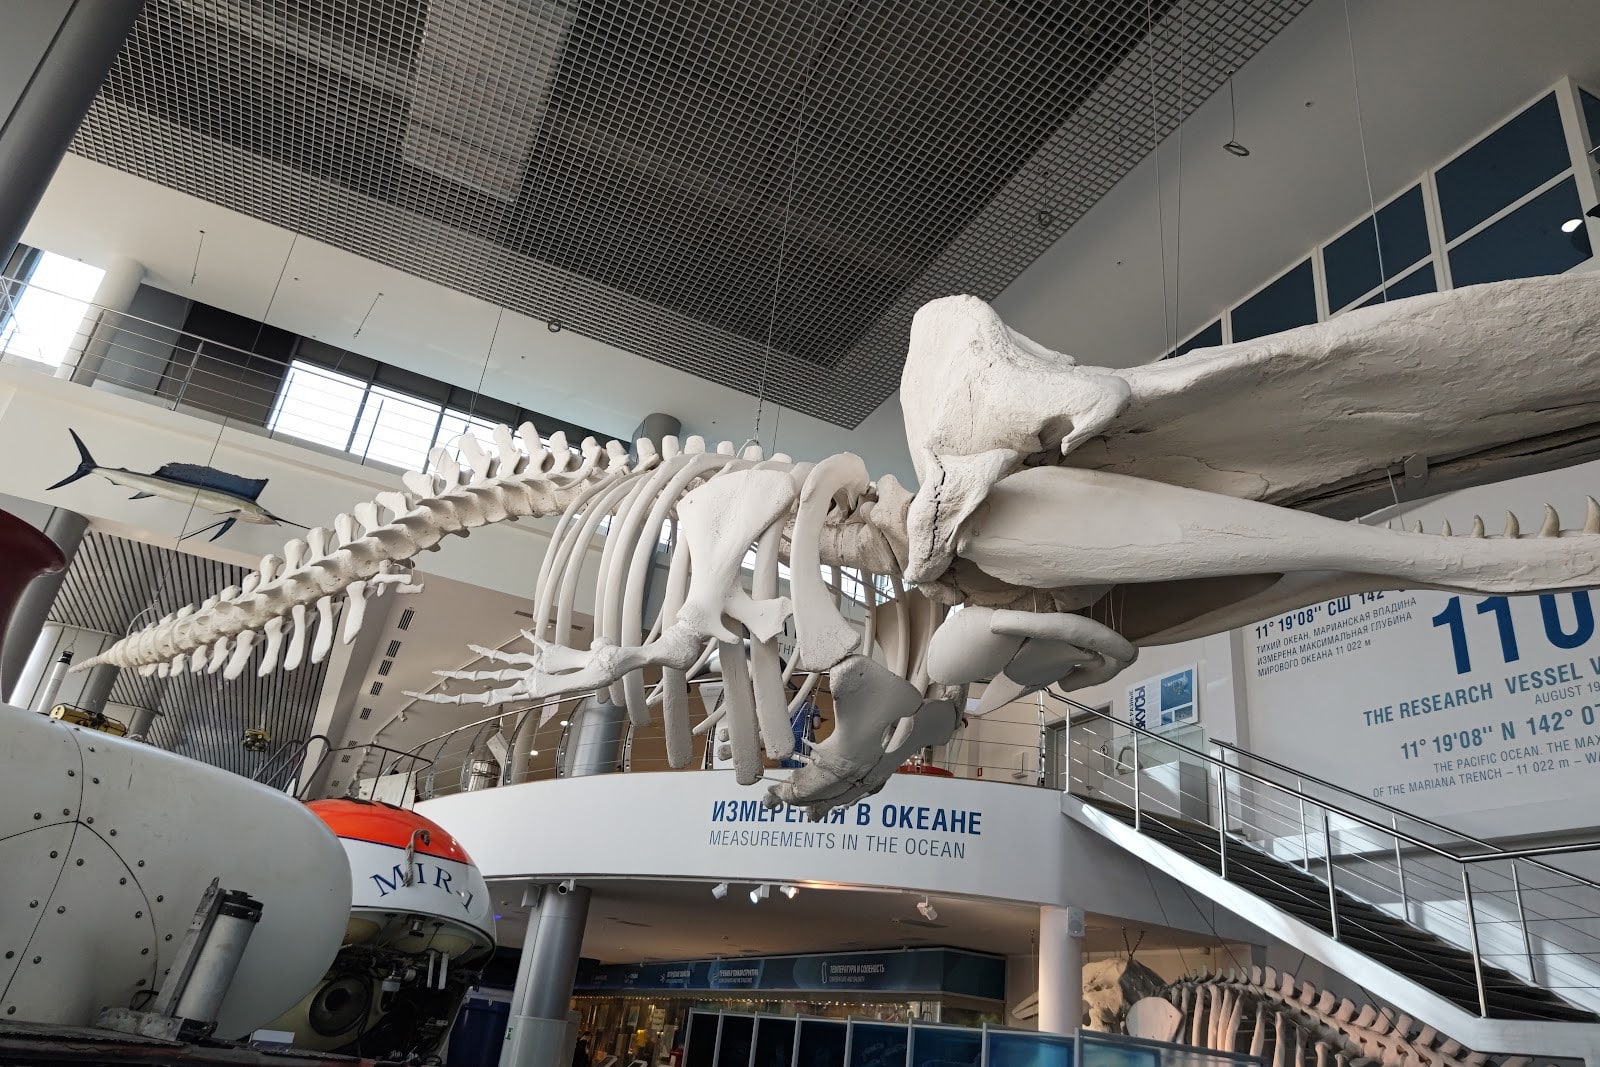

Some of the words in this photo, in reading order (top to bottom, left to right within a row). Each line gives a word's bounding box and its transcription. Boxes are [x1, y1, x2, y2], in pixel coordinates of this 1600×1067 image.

[1257, 638, 1281, 654] ТИХИЙ
[1313, 611, 1371, 637] МАРИАНСКАЯ
[1372, 597, 1417, 619] ВПАДИНА
[1257, 647, 1298, 666] ИЗМЕРЕНА
[1299, 625, 1369, 653] МАКСИМАЛЬНАЯ
[1370, 612, 1413, 632] ГЛУБИНА
[1257, 658, 1299, 677] МИРОВОГО
[1301, 648, 1333, 665] ОКЕАНА
[1335, 645, 1344, 655] 11
[1346, 639, 1362, 652] 022
[1363, 706, 1394, 726] THE
[1399, 682, 1494, 719] RESEARCH
[1504, 662, 1584, 695] VESSEL
[1534, 684, 1582, 705] AUGUST
[1500, 720, 1517, 741] N
[1433, 760, 1454, 773] THE
[1456, 751, 1498, 770] PACIFIC
[1546, 739, 1571, 754] THE
[1373, 786, 1385, 798] OF
[1387, 783, 1407, 796] THE
[1408, 775, 1457, 793] MARIANA
[1458, 766, 1503, 785] TRENCH
[1516, 764, 1529, 775] 11
[1532, 758, 1556, 774] 022
[1558, 758, 1571, 769] m
[711, 800, 846, 825] ИЗМЕРЕЯ
[856, 803, 872, 826] В
[881, 804, 983, 835] ОКЕАНЕ
[708, 829, 836, 850] MEASUREMENTS
[841, 833, 859, 851] IN
[865, 835, 899, 854] THE
[904, 837, 966, 859] OCEAN
